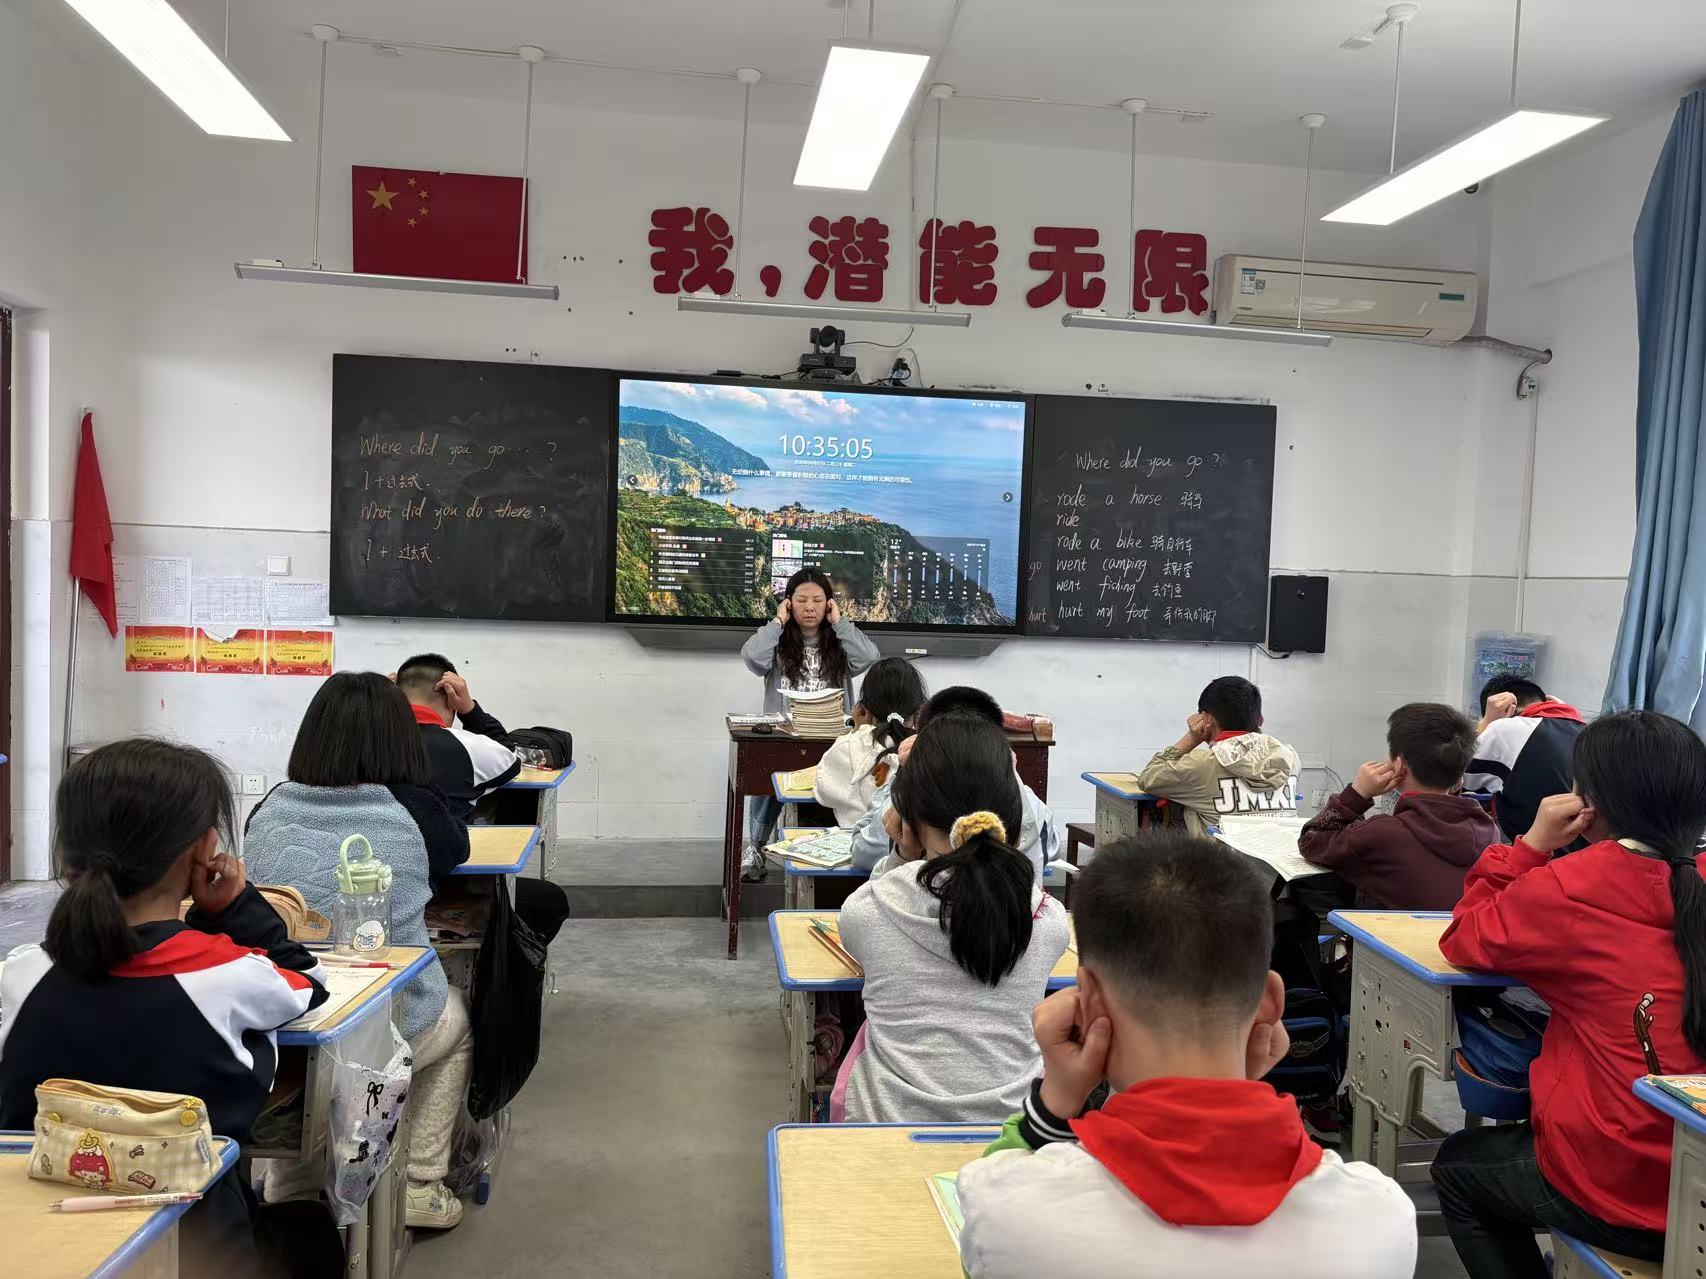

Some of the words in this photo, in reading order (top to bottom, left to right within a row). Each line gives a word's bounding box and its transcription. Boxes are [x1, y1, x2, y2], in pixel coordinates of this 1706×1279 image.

[360, 433, 403, 456] Where
[410, 432, 439, 456] did
[448, 446, 472, 465] you
[779, 434, 873, 459] 10:35:05
[1076, 453, 1110, 470] Where
[1120, 447, 1142, 469] did
[1146, 456, 1172, 477] you
[1185, 455, 1203, 477] go
[1057, 484, 1087, 507] rode
[1105, 495, 1115, 506] a
[1130, 484, 1162, 506] horse
[361, 501, 393, 520] What
[401, 497, 426, 521] did
[432, 506, 459, 530] you
[466, 497, 483, 518] do
[495, 499, 533, 519] there
[1056, 509, 1080, 527] ride
[1057, 532, 1082, 550] rode
[1090, 537, 1102, 550] a
[1116, 528, 1143, 549] bike
[1150, 535, 1194, 556] 骑自行车
[1028, 560, 1042, 581] go
[1056, 558, 1087, 572] went
[1102, 556, 1147, 582] camping
[1056, 579, 1081, 593] went
[1099, 576, 1136, 607] fishing
[1029, 607, 1047, 623] hurt
[1058, 601, 1083, 618] hurt
[1097, 606, 1113, 627] my
[1126, 604, 1151, 623] foot
